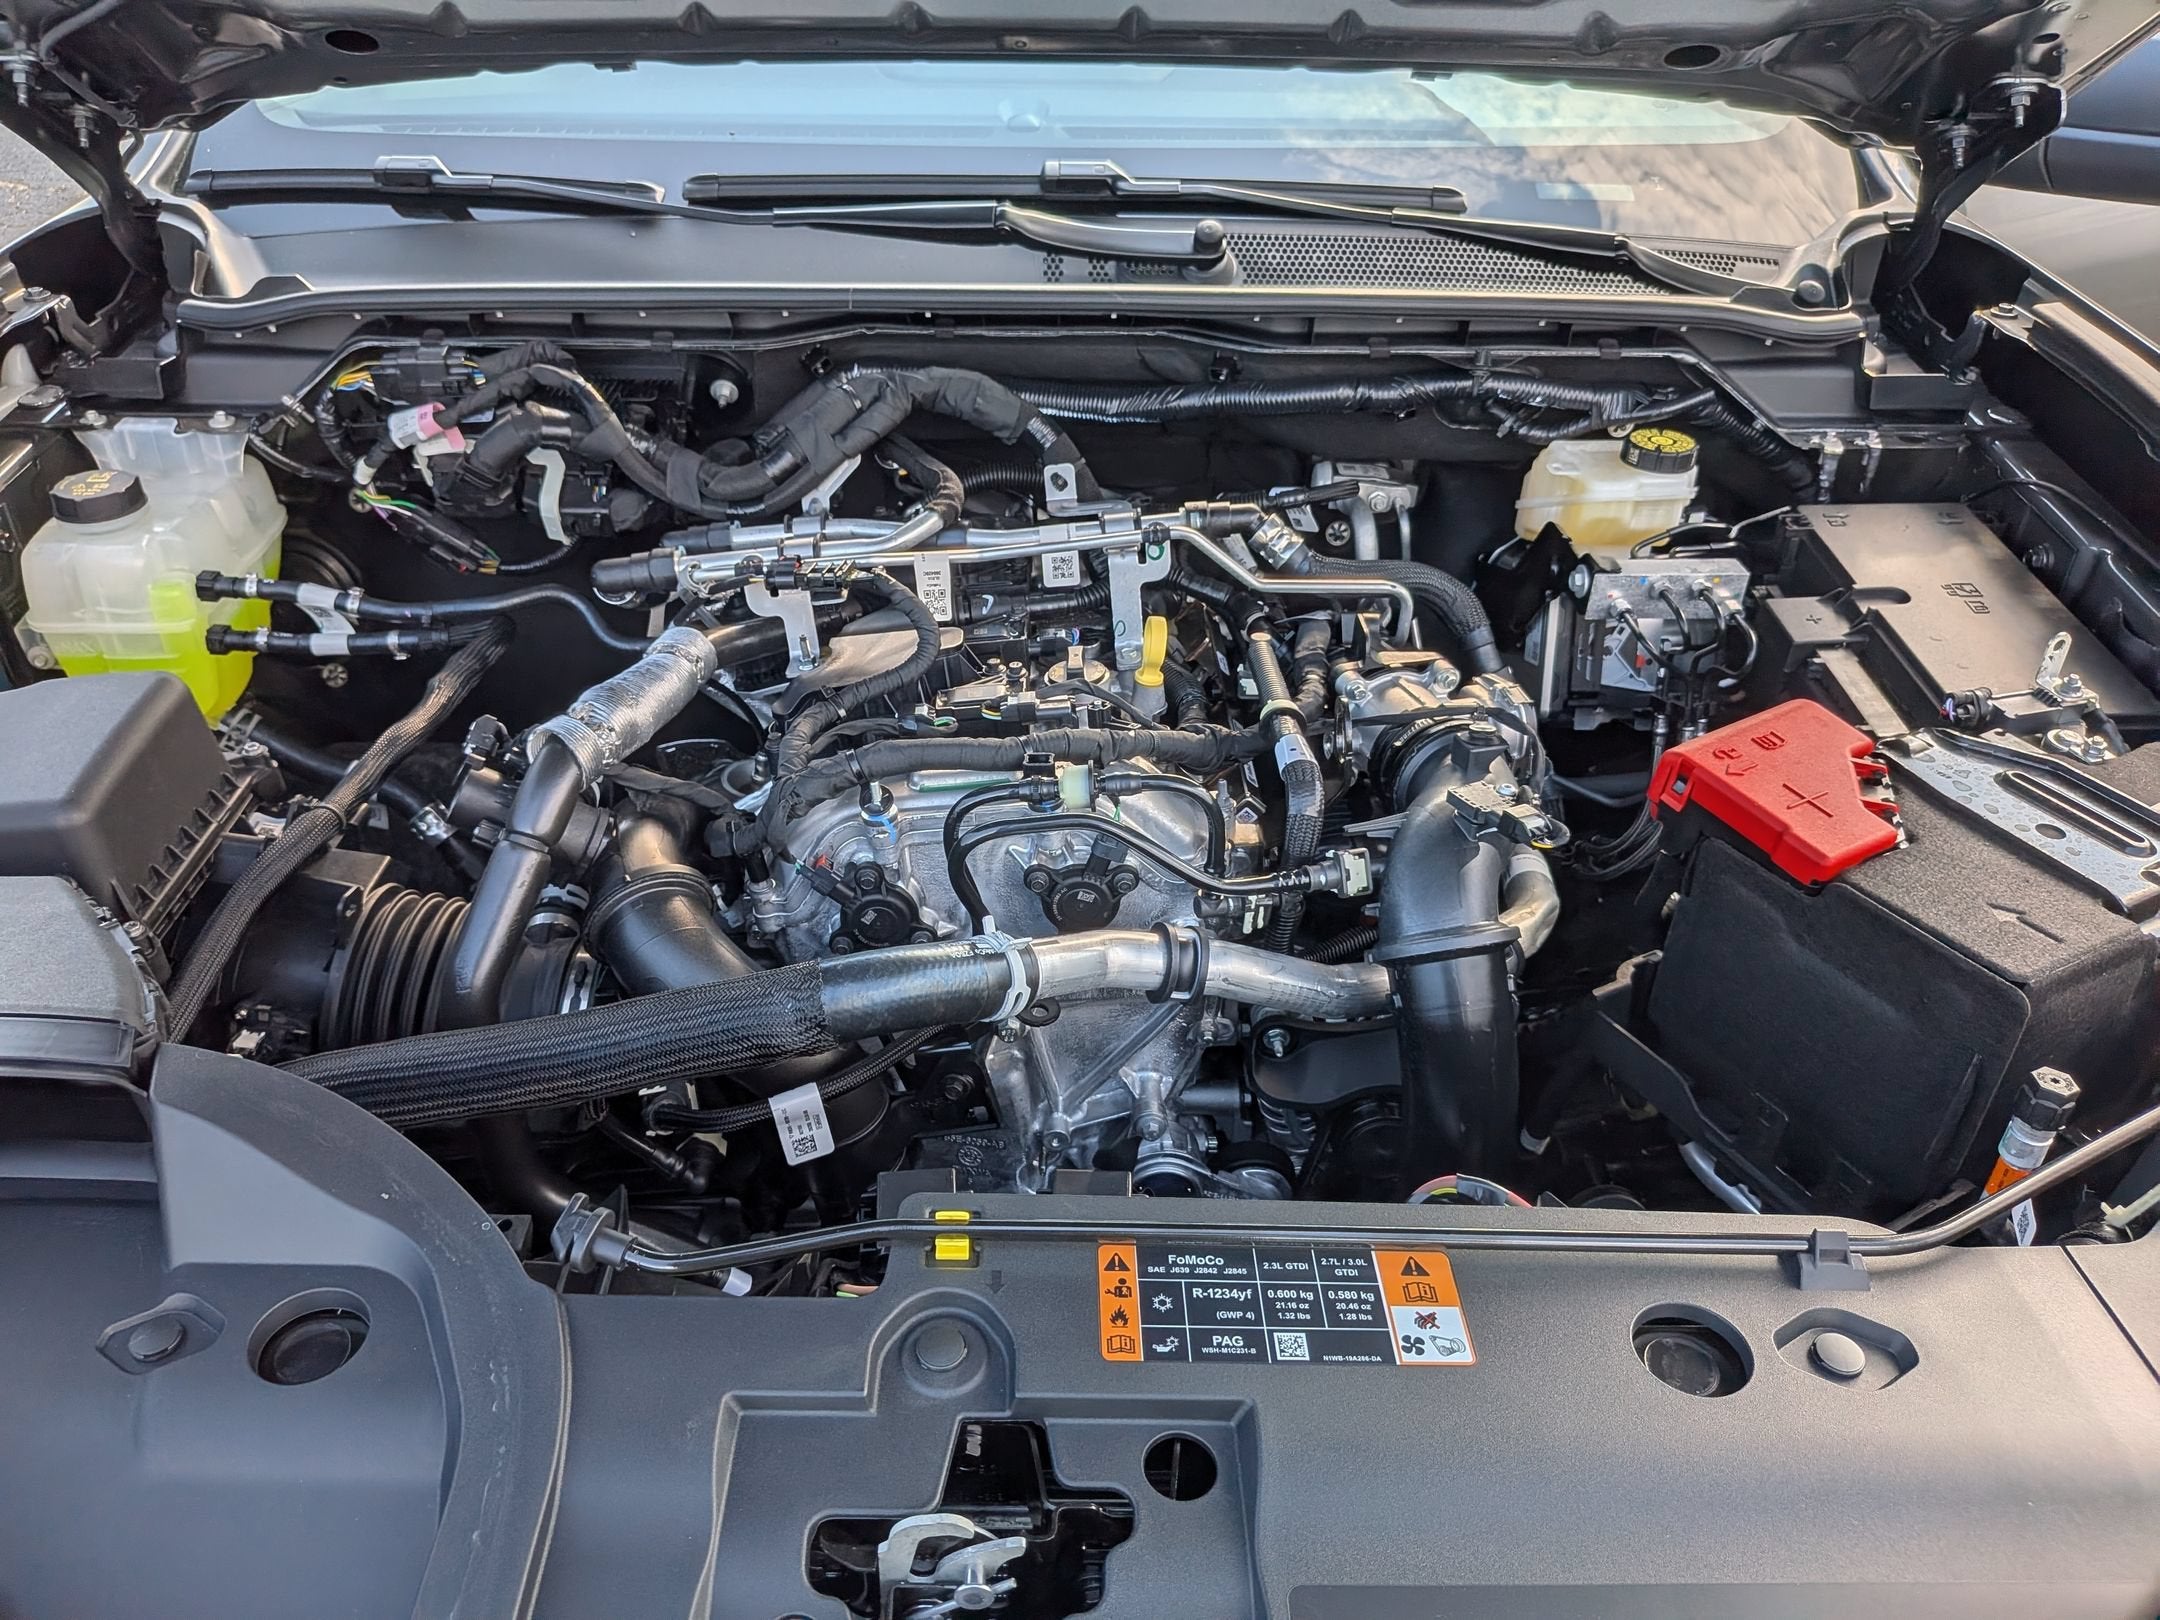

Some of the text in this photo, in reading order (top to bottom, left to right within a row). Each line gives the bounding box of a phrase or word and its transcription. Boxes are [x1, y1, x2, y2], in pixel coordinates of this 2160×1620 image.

[1168, 1255, 1224, 1265] FoMoCo
[1321, 1258, 1341, 1266] 2.7L
[1348, 1258, 1368, 1266] 3.0L
[1170, 1266, 1190, 1274] J639
[1194, 1267, 1218, 1275] J2842
[1263, 1262, 1309, 1270] 2.3L GTDI
[1334, 1268, 1359, 1276] GTDI
[1192, 1288, 1252, 1301] R-1234yf
[1267, 1289, 1314, 1300] 0.600 kg
[1327, 1290, 1375, 1301] 0.580 kg
[1275, 1301, 1297, 1309] 21.16
[1335, 1302, 1359, 1310] 20.46
[1216, 1311, 1255, 1320] (GWP 4)
[1277, 1312, 1311, 1320] 1.32 lbs
[1358, 1312, 1373, 1321] lbs
[1212, 1335, 1244, 1347] PAG
[1201, 1346, 1256, 1354] WSH-M1C231-B
